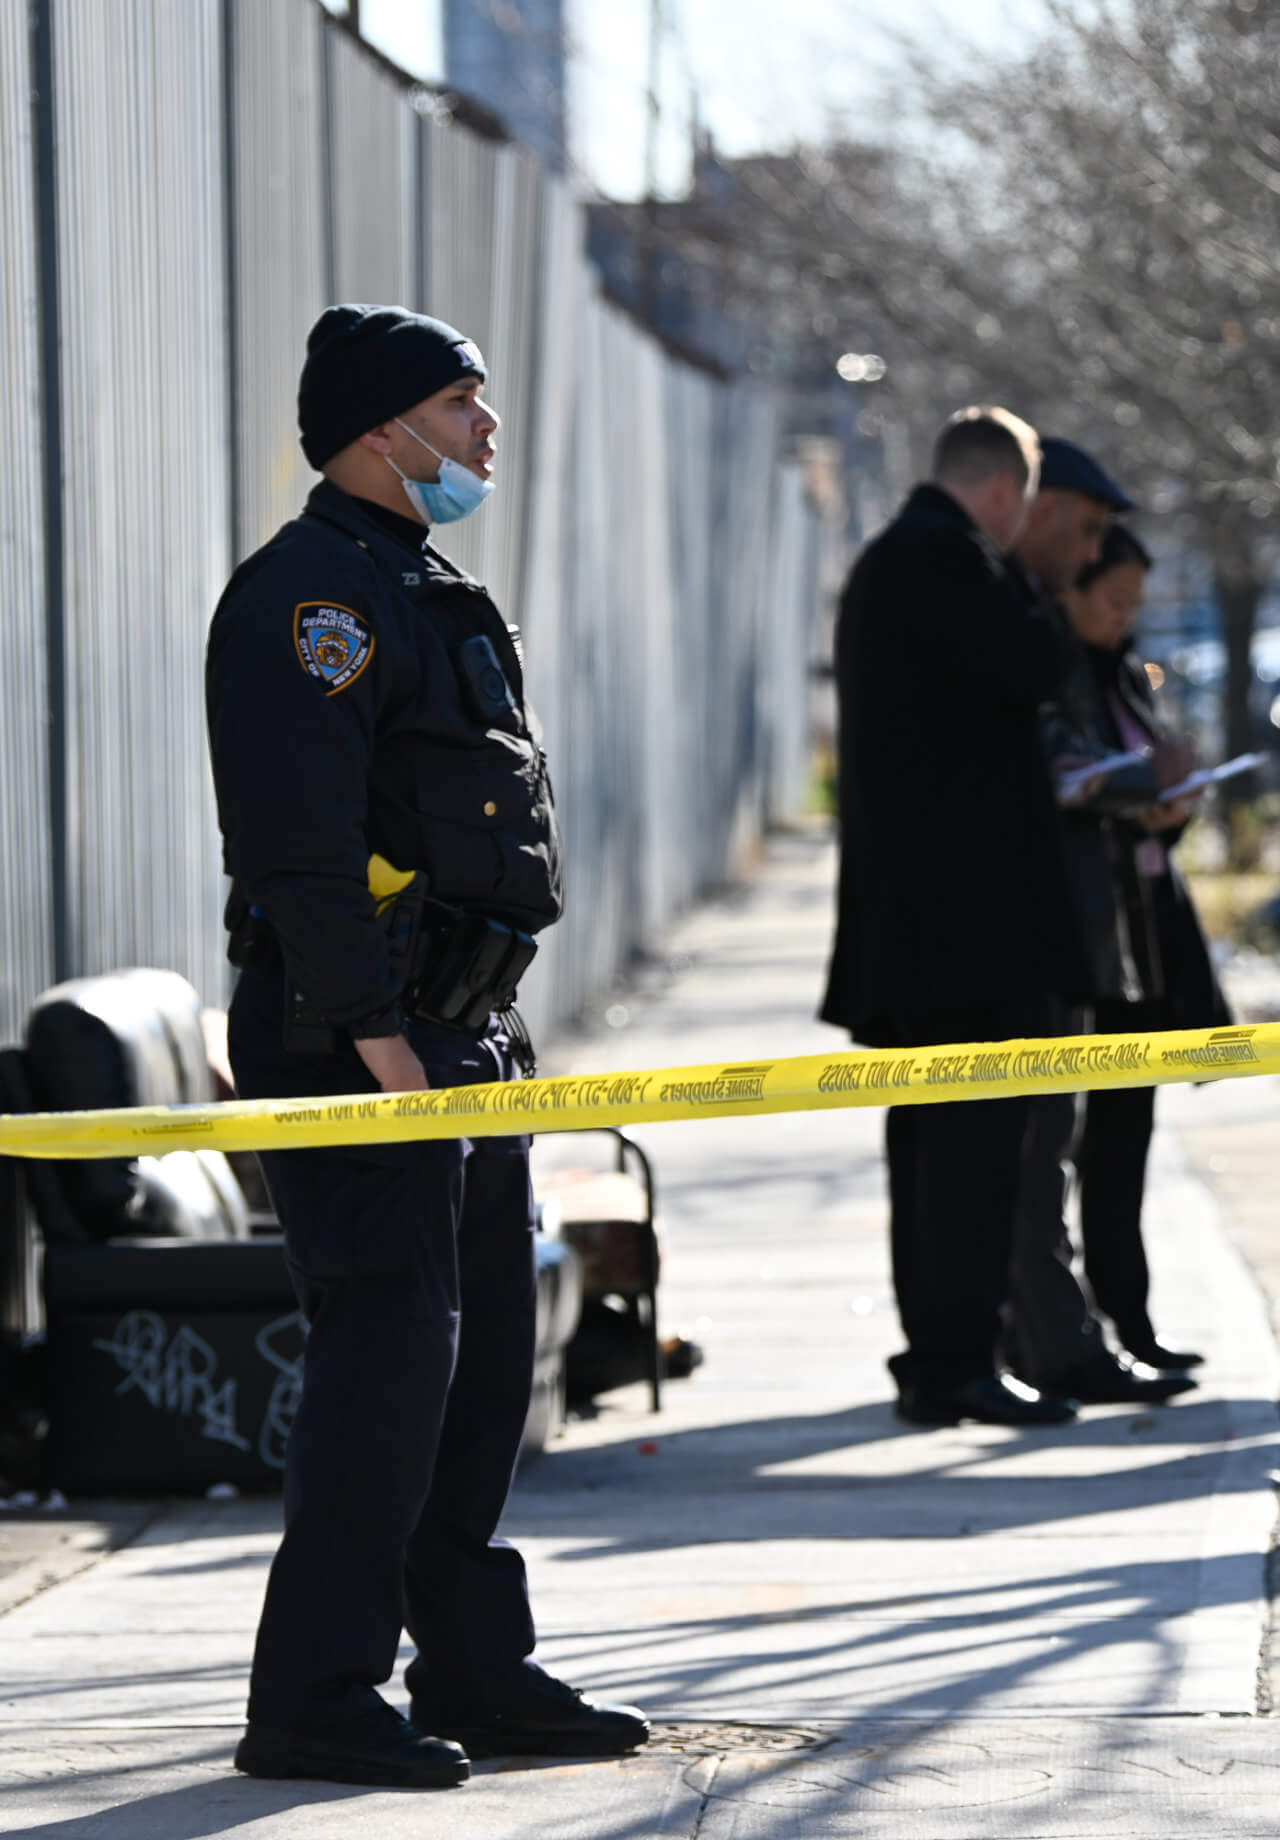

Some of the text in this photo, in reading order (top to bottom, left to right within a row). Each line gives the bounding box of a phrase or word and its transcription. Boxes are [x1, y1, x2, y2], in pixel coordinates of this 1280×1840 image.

[303, 618, 367, 641] DEPARTMENT
[318, 608, 356, 625] POLICE
[299, 638, 321, 677] CITY OF
[332, 647, 369, 687] NEW YORK
